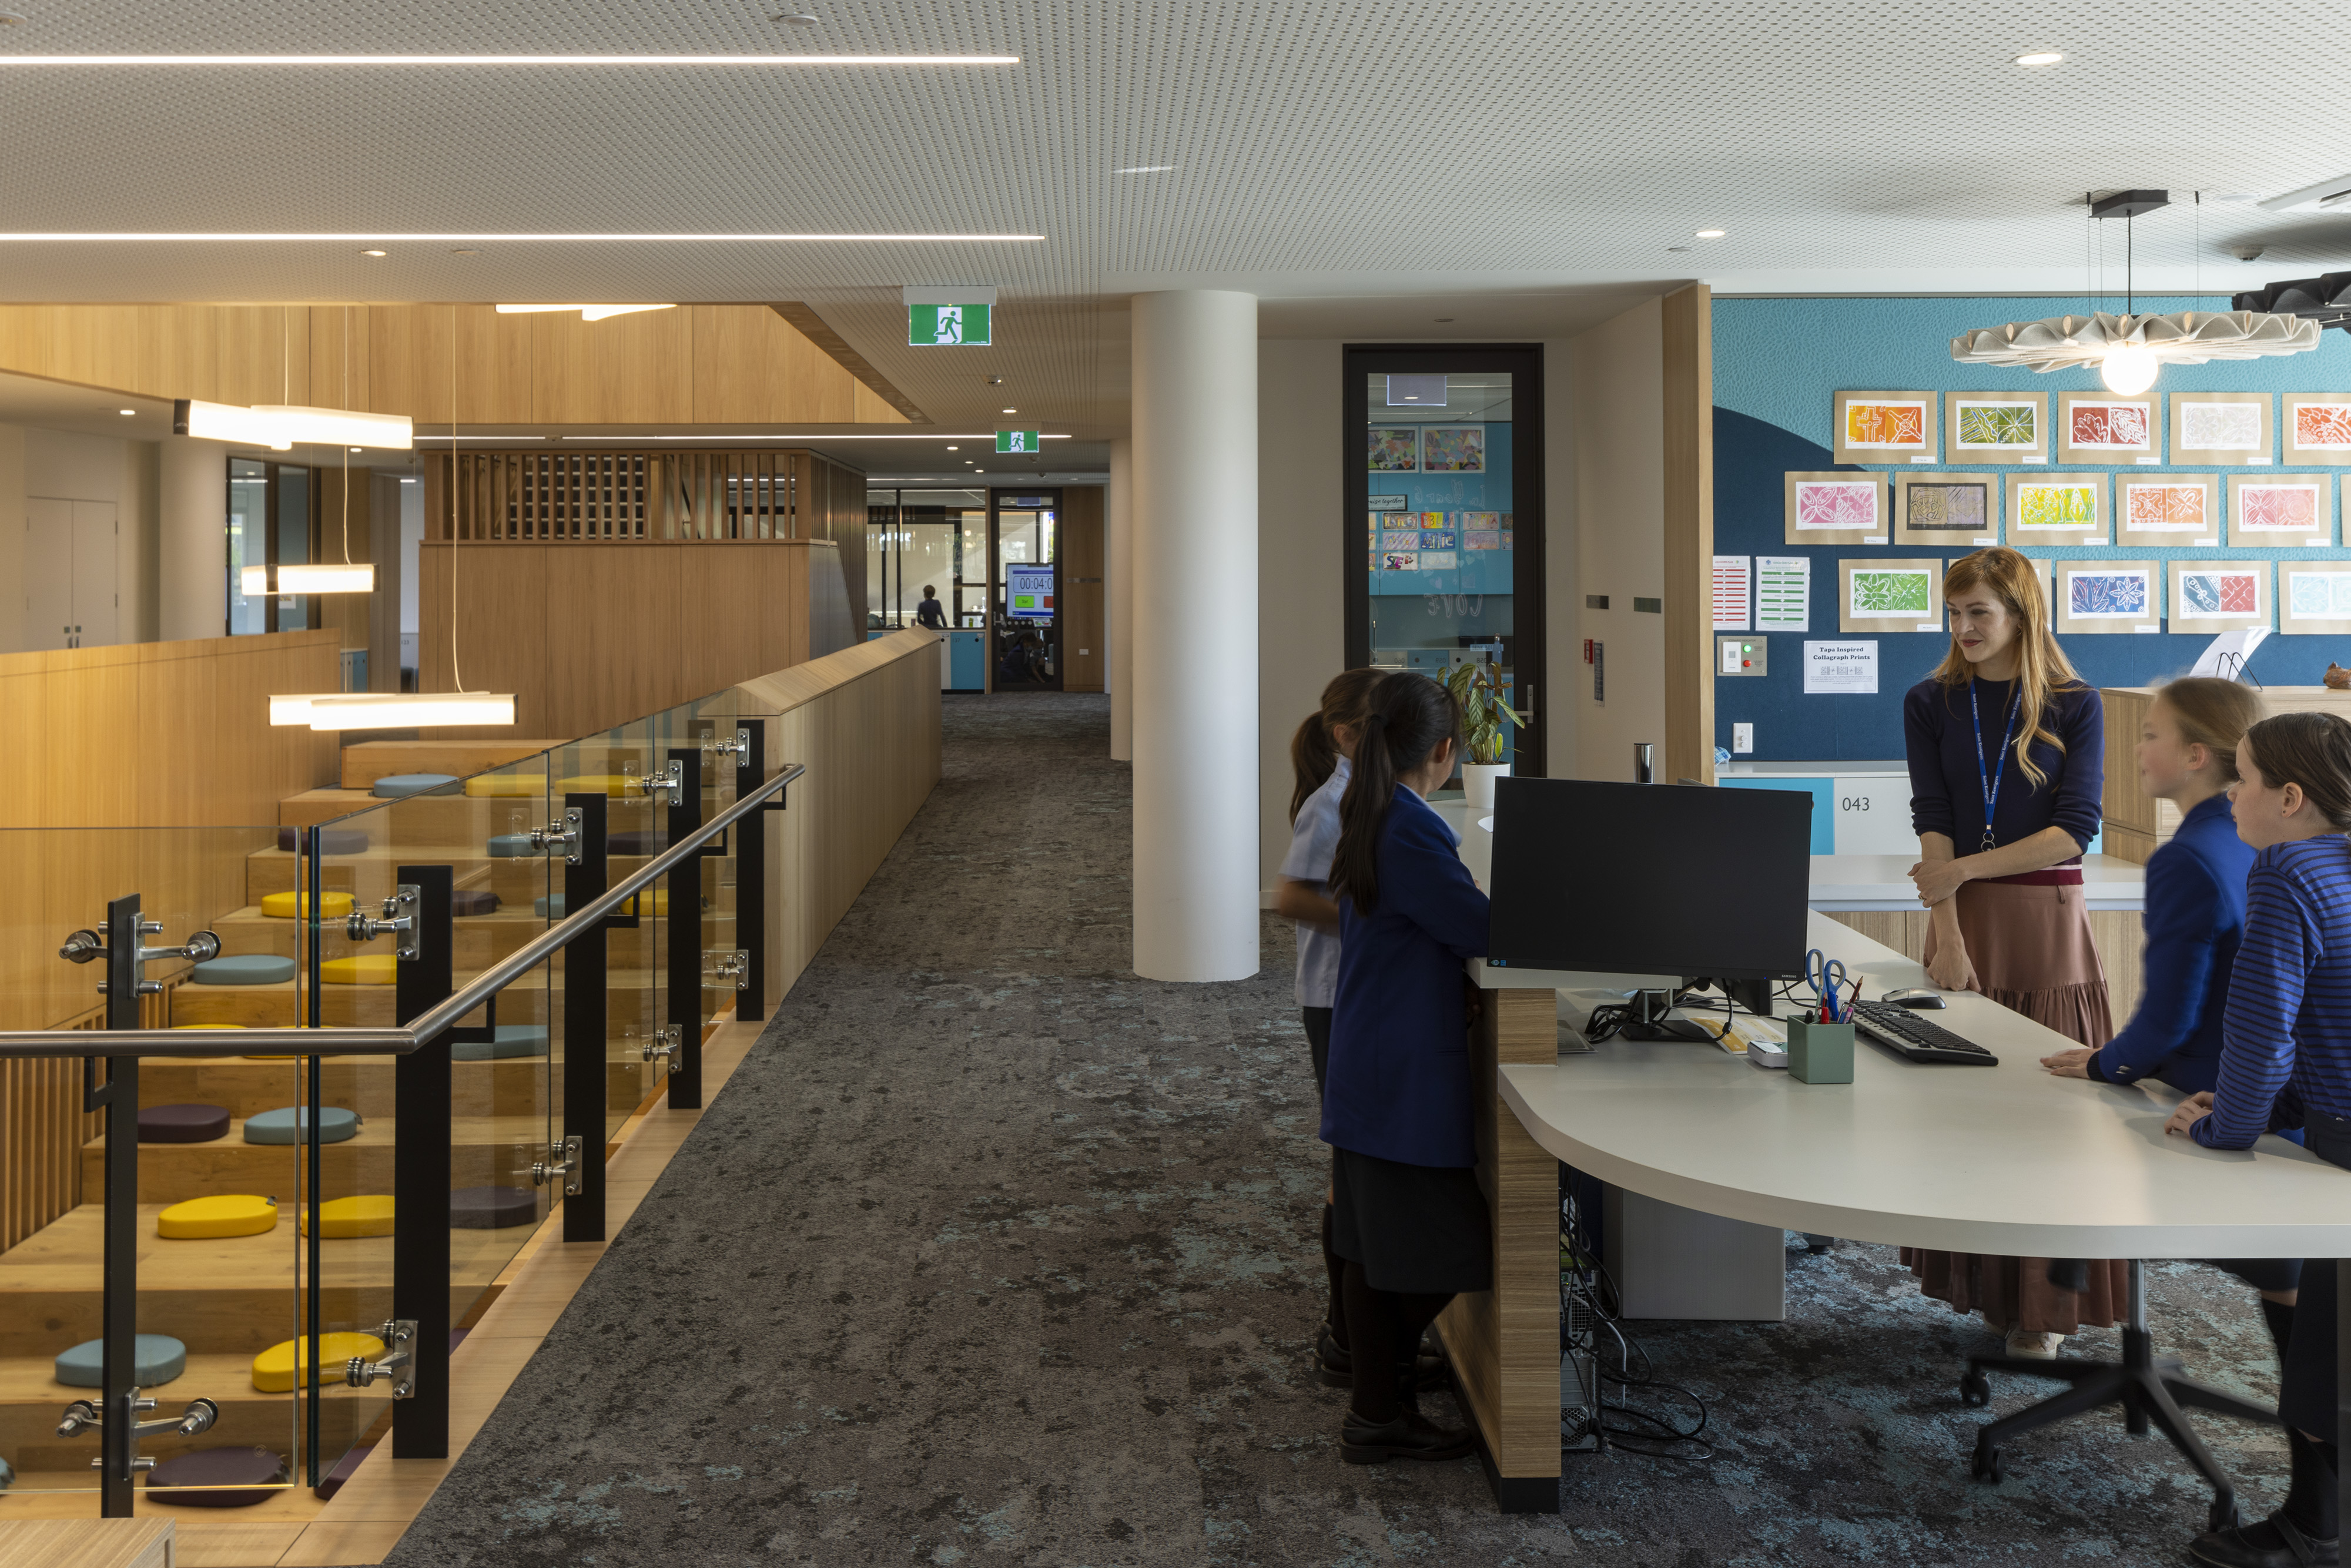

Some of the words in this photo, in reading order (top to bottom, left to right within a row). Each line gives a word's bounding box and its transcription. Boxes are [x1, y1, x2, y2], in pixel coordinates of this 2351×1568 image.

[1382, 497, 1404, 506] together
[1020, 577, 1053, 589] 00:04:0
[1843, 797, 1870, 811] 043
